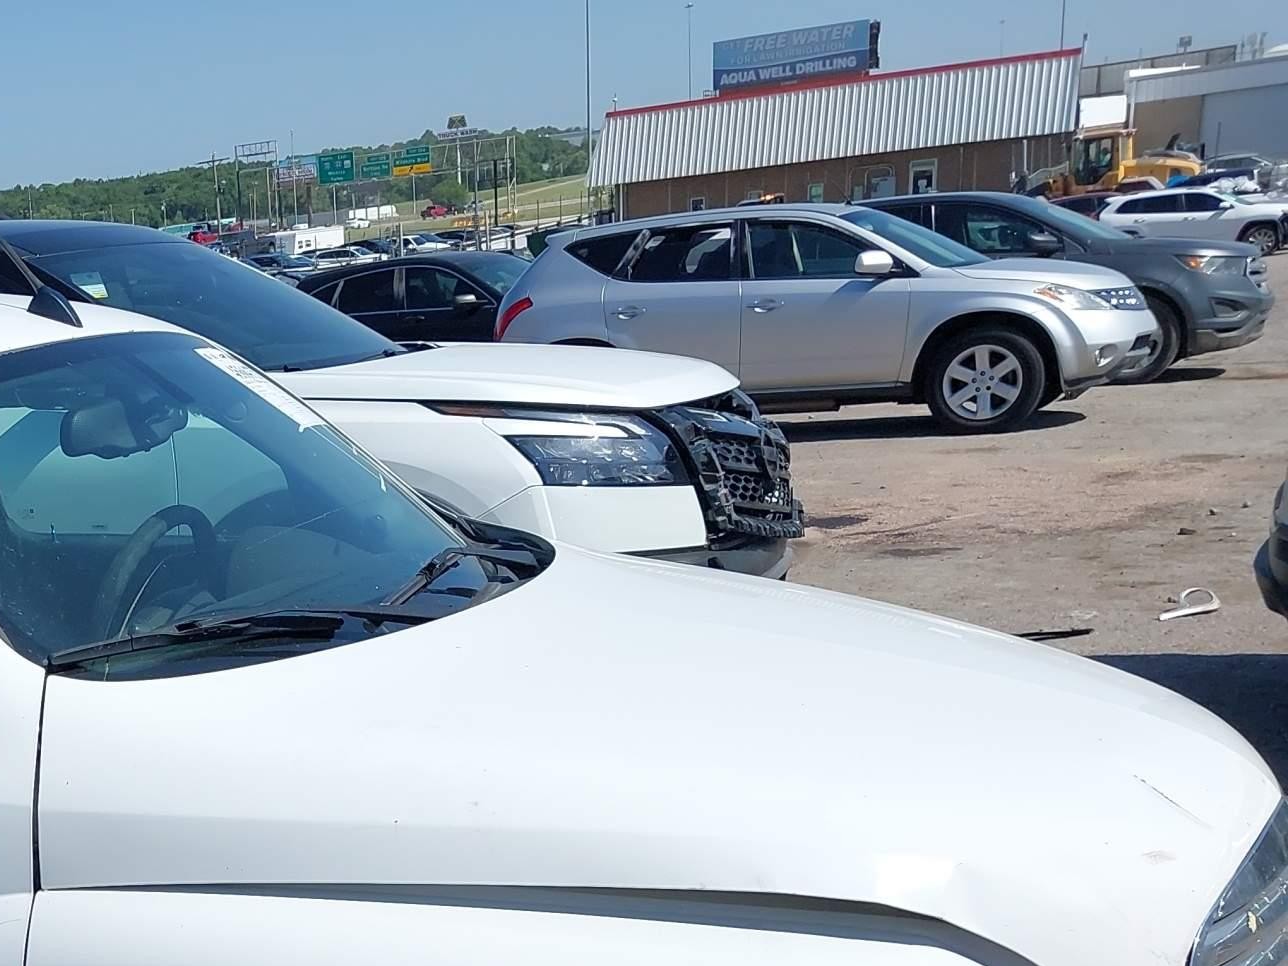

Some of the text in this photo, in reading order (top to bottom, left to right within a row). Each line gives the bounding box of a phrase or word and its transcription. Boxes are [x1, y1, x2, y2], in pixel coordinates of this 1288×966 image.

[743, 34, 788, 53] FREE
[792, 24, 855, 46] WATER
[720, 55, 857, 86] AQUA WELL DRILLING
